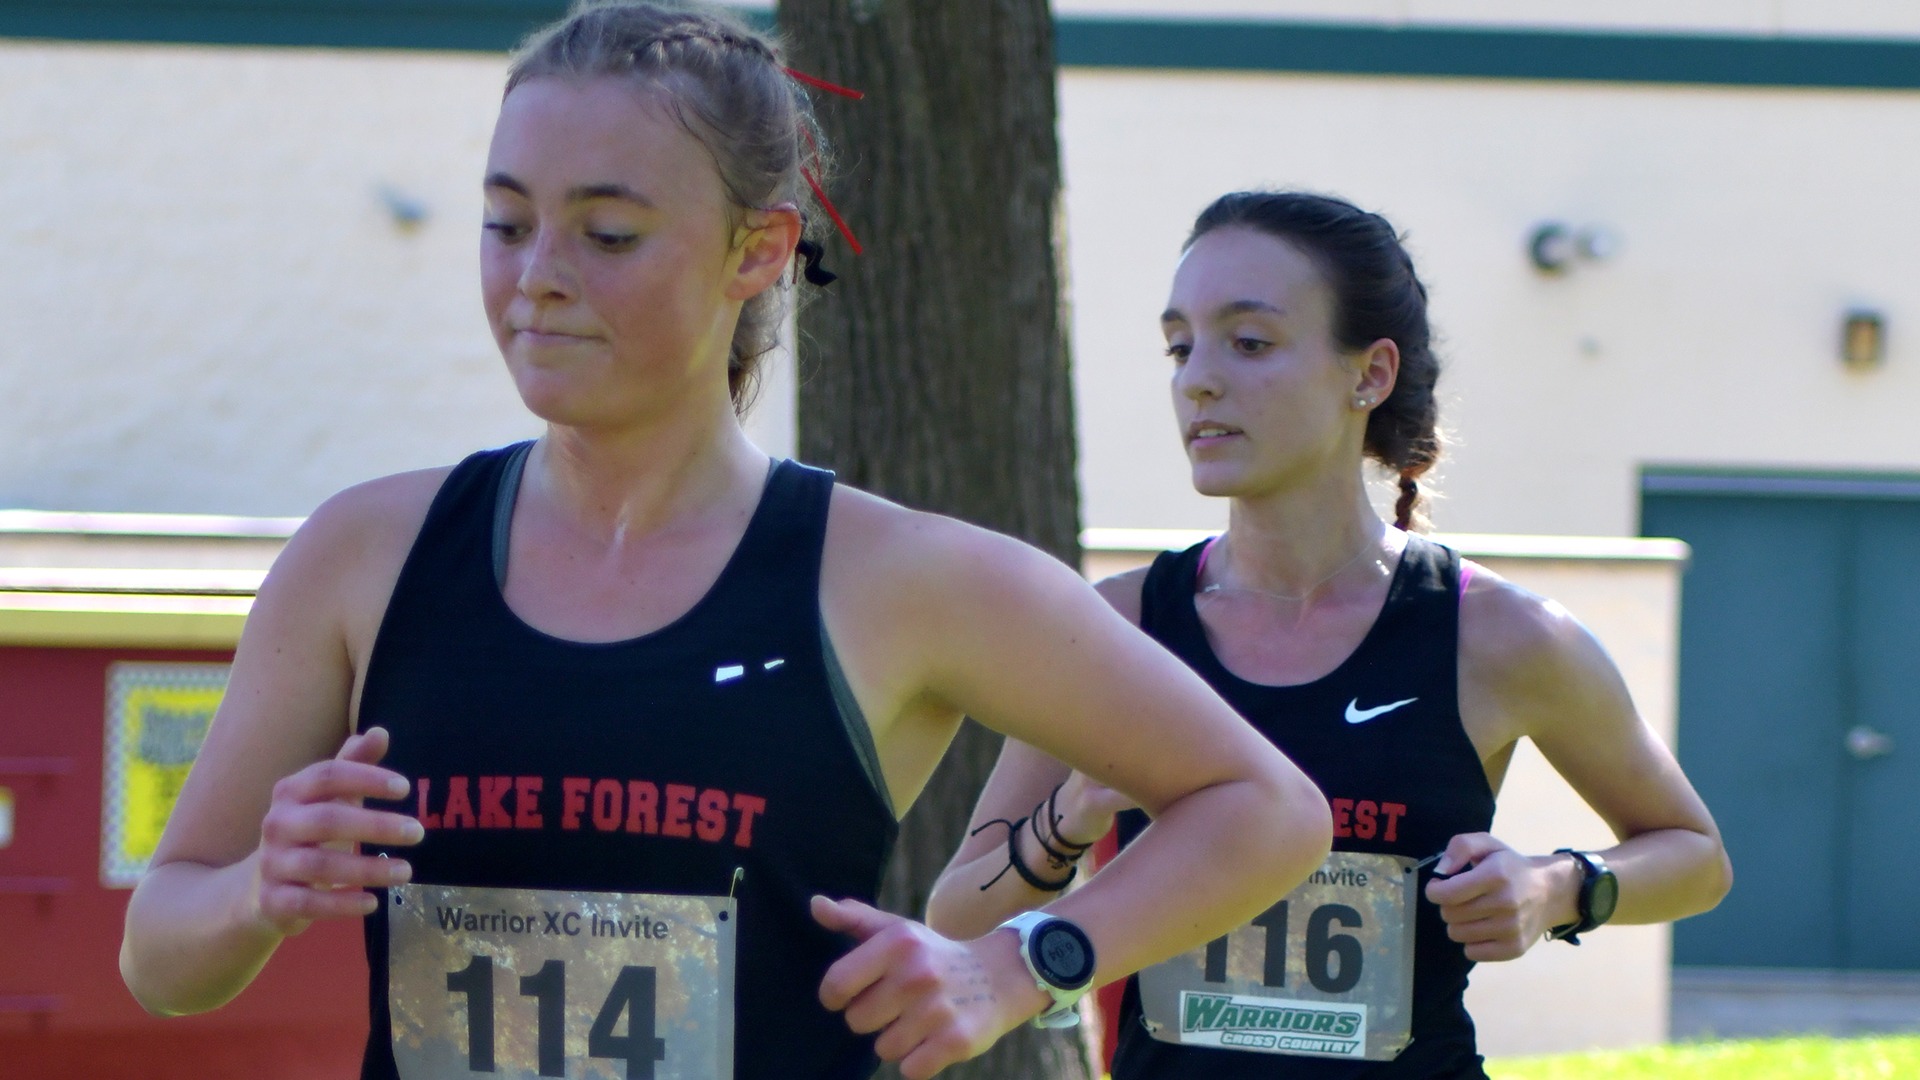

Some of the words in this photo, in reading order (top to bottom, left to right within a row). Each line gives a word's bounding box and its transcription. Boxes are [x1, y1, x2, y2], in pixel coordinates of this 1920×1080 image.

[417, 776, 544, 830] LAKE
[561, 776, 767, 848] FOREST
[1332, 798, 1407, 843] EST
[436, 906, 536, 934] Warrior
[543, 911, 582, 936] XC
[591, 913, 669, 940] Invite
[446, 955, 666, 1080] 114
[1184, 993, 1361, 1037] WARRIORS
[1221, 1031, 1276, 1048] CROSS
[1278, 1036, 1360, 1054] COUNTRY
